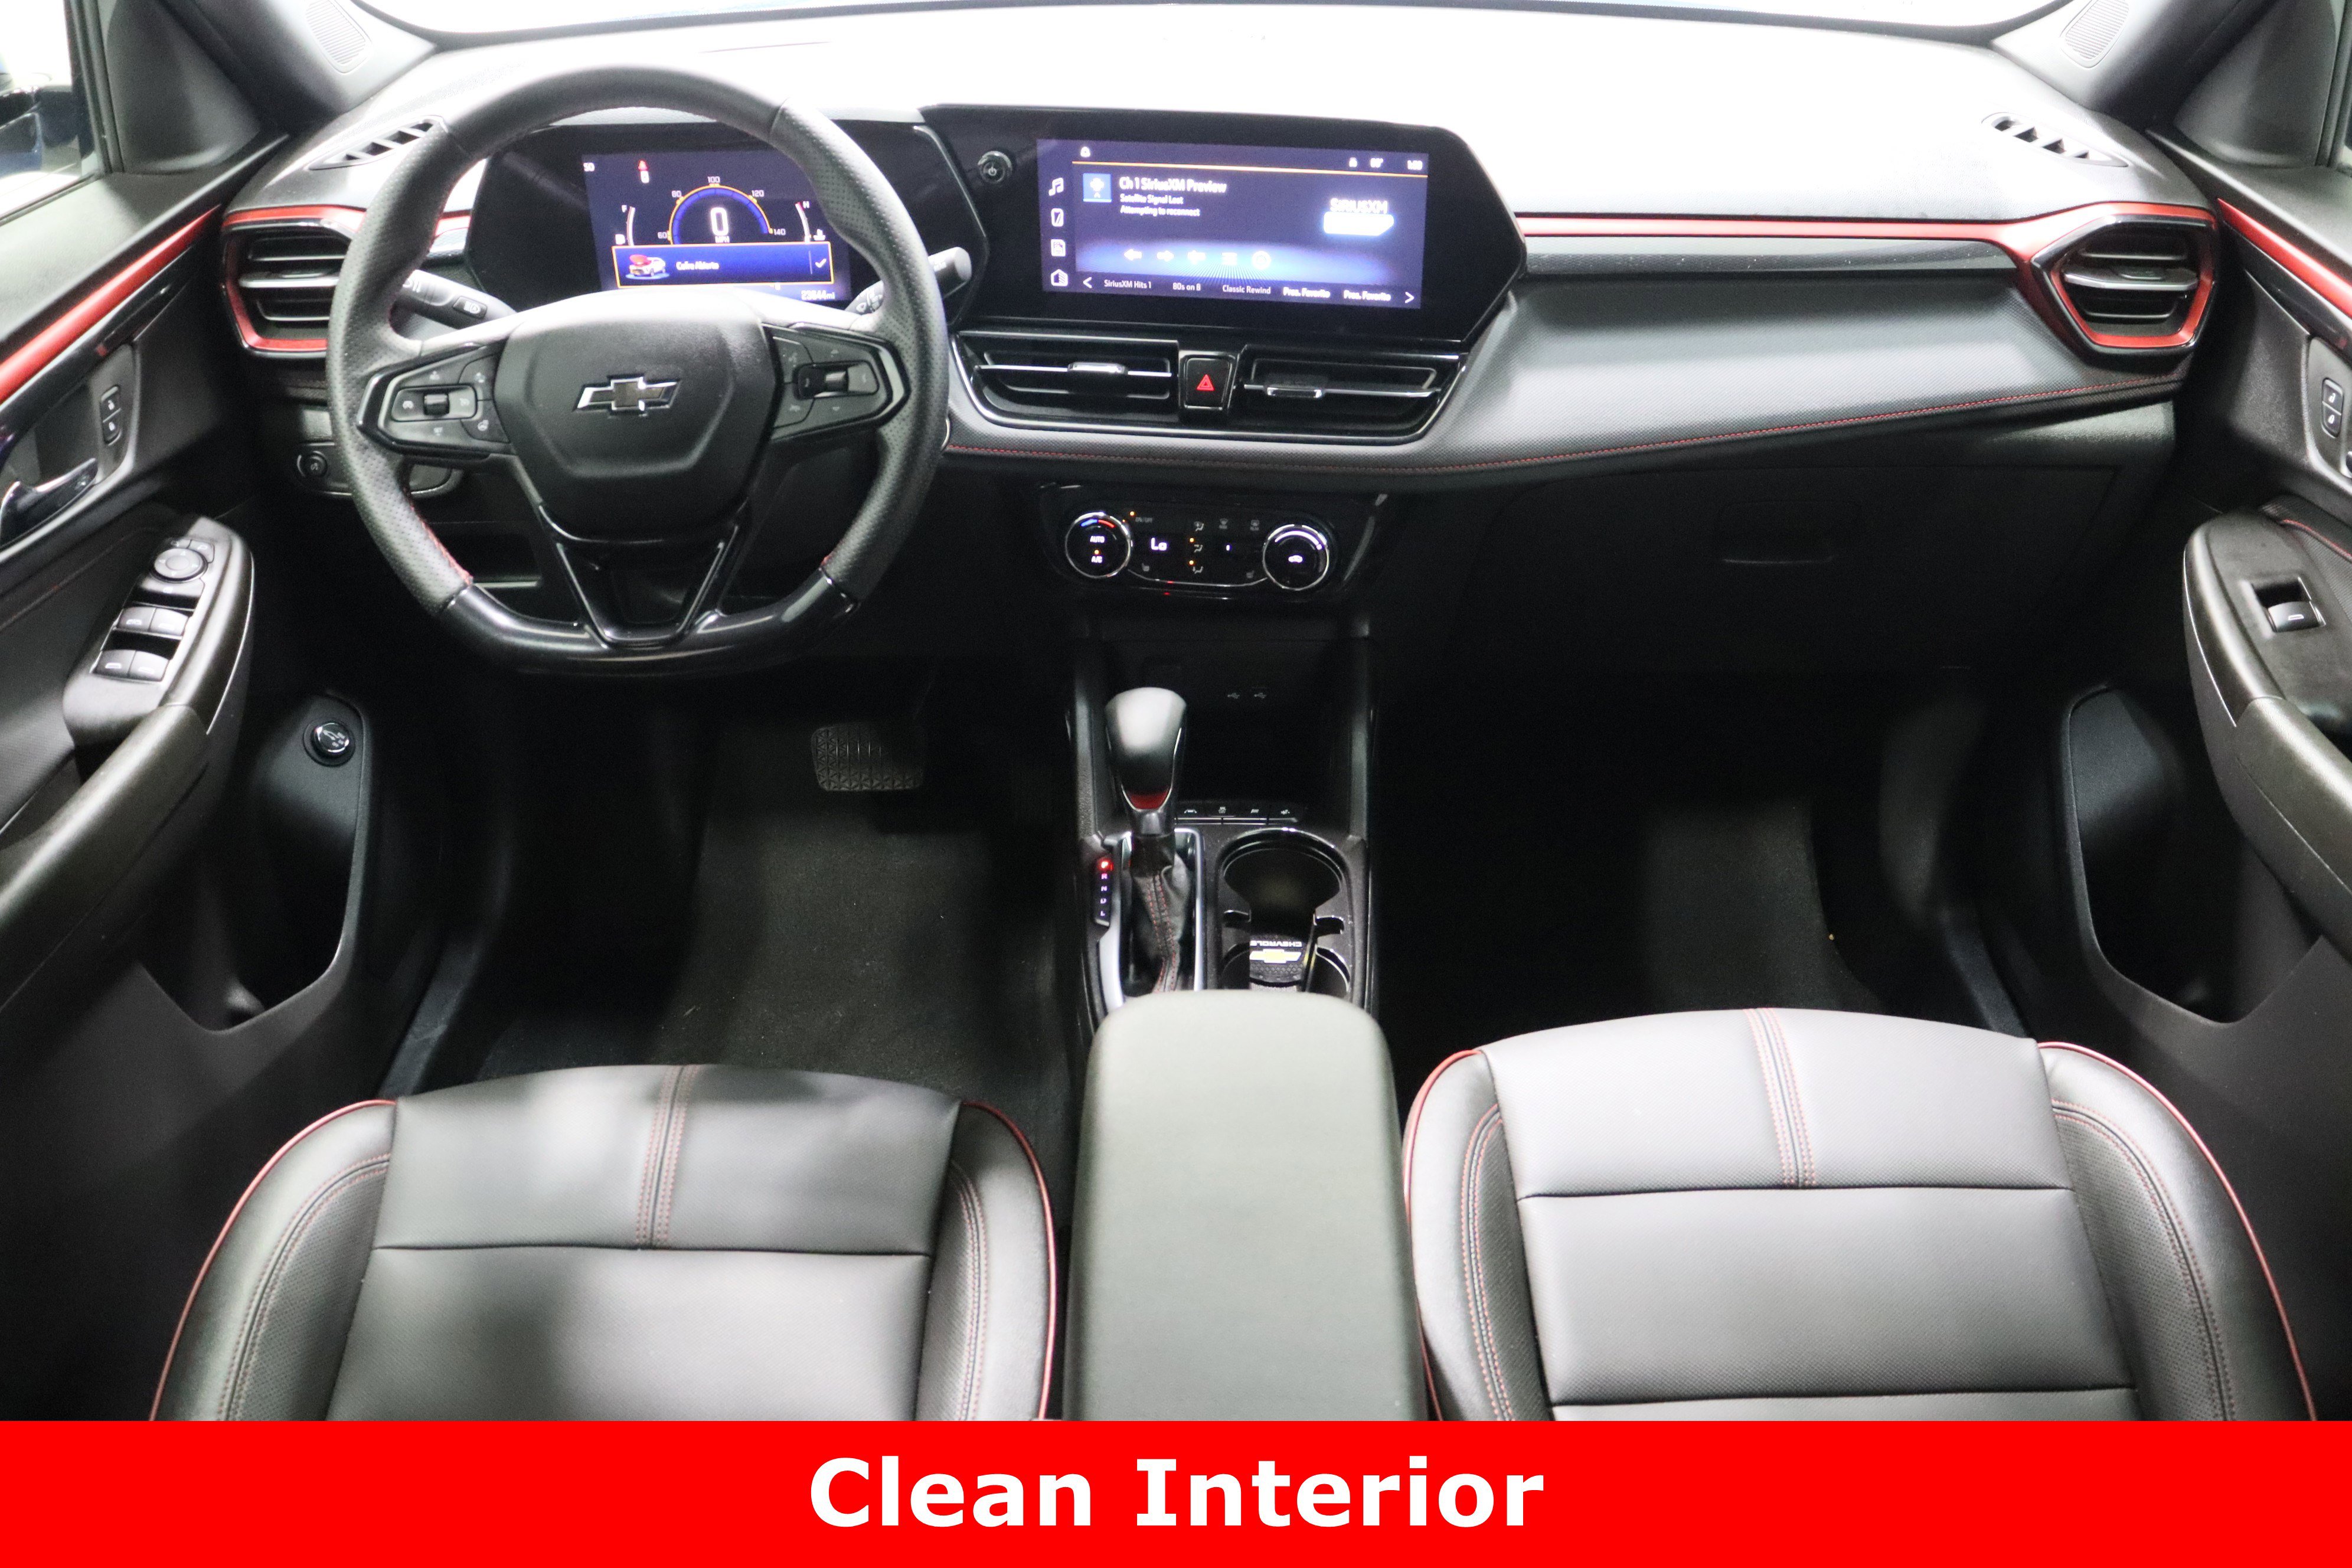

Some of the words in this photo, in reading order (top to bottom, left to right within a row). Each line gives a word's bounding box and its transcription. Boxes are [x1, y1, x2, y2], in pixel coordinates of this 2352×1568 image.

[1119, 177, 1133, 190] Ch
[1135, 177, 1140, 190] 1
[1141, 177, 1185, 191] SiriusXM
[1187, 179, 1227, 193] Preview
[1147, 194, 1168, 205] Signal
[1168, 195, 1184, 204] Lost
[621, 204, 627, 213] F
[1120, 205, 1158, 217] Attempting
[1158, 207, 1166, 215] to
[1166, 208, 1201, 217] reconnect
[710, 207, 729, 236] 0
[1104, 279, 1132, 289] SiriusXM
[1172, 282, 1185, 290] 80s
[1222, 285, 1245, 293] Classic
[1246, 286, 1271, 294] Rewind
[1151, 537, 1167, 551] Lo
